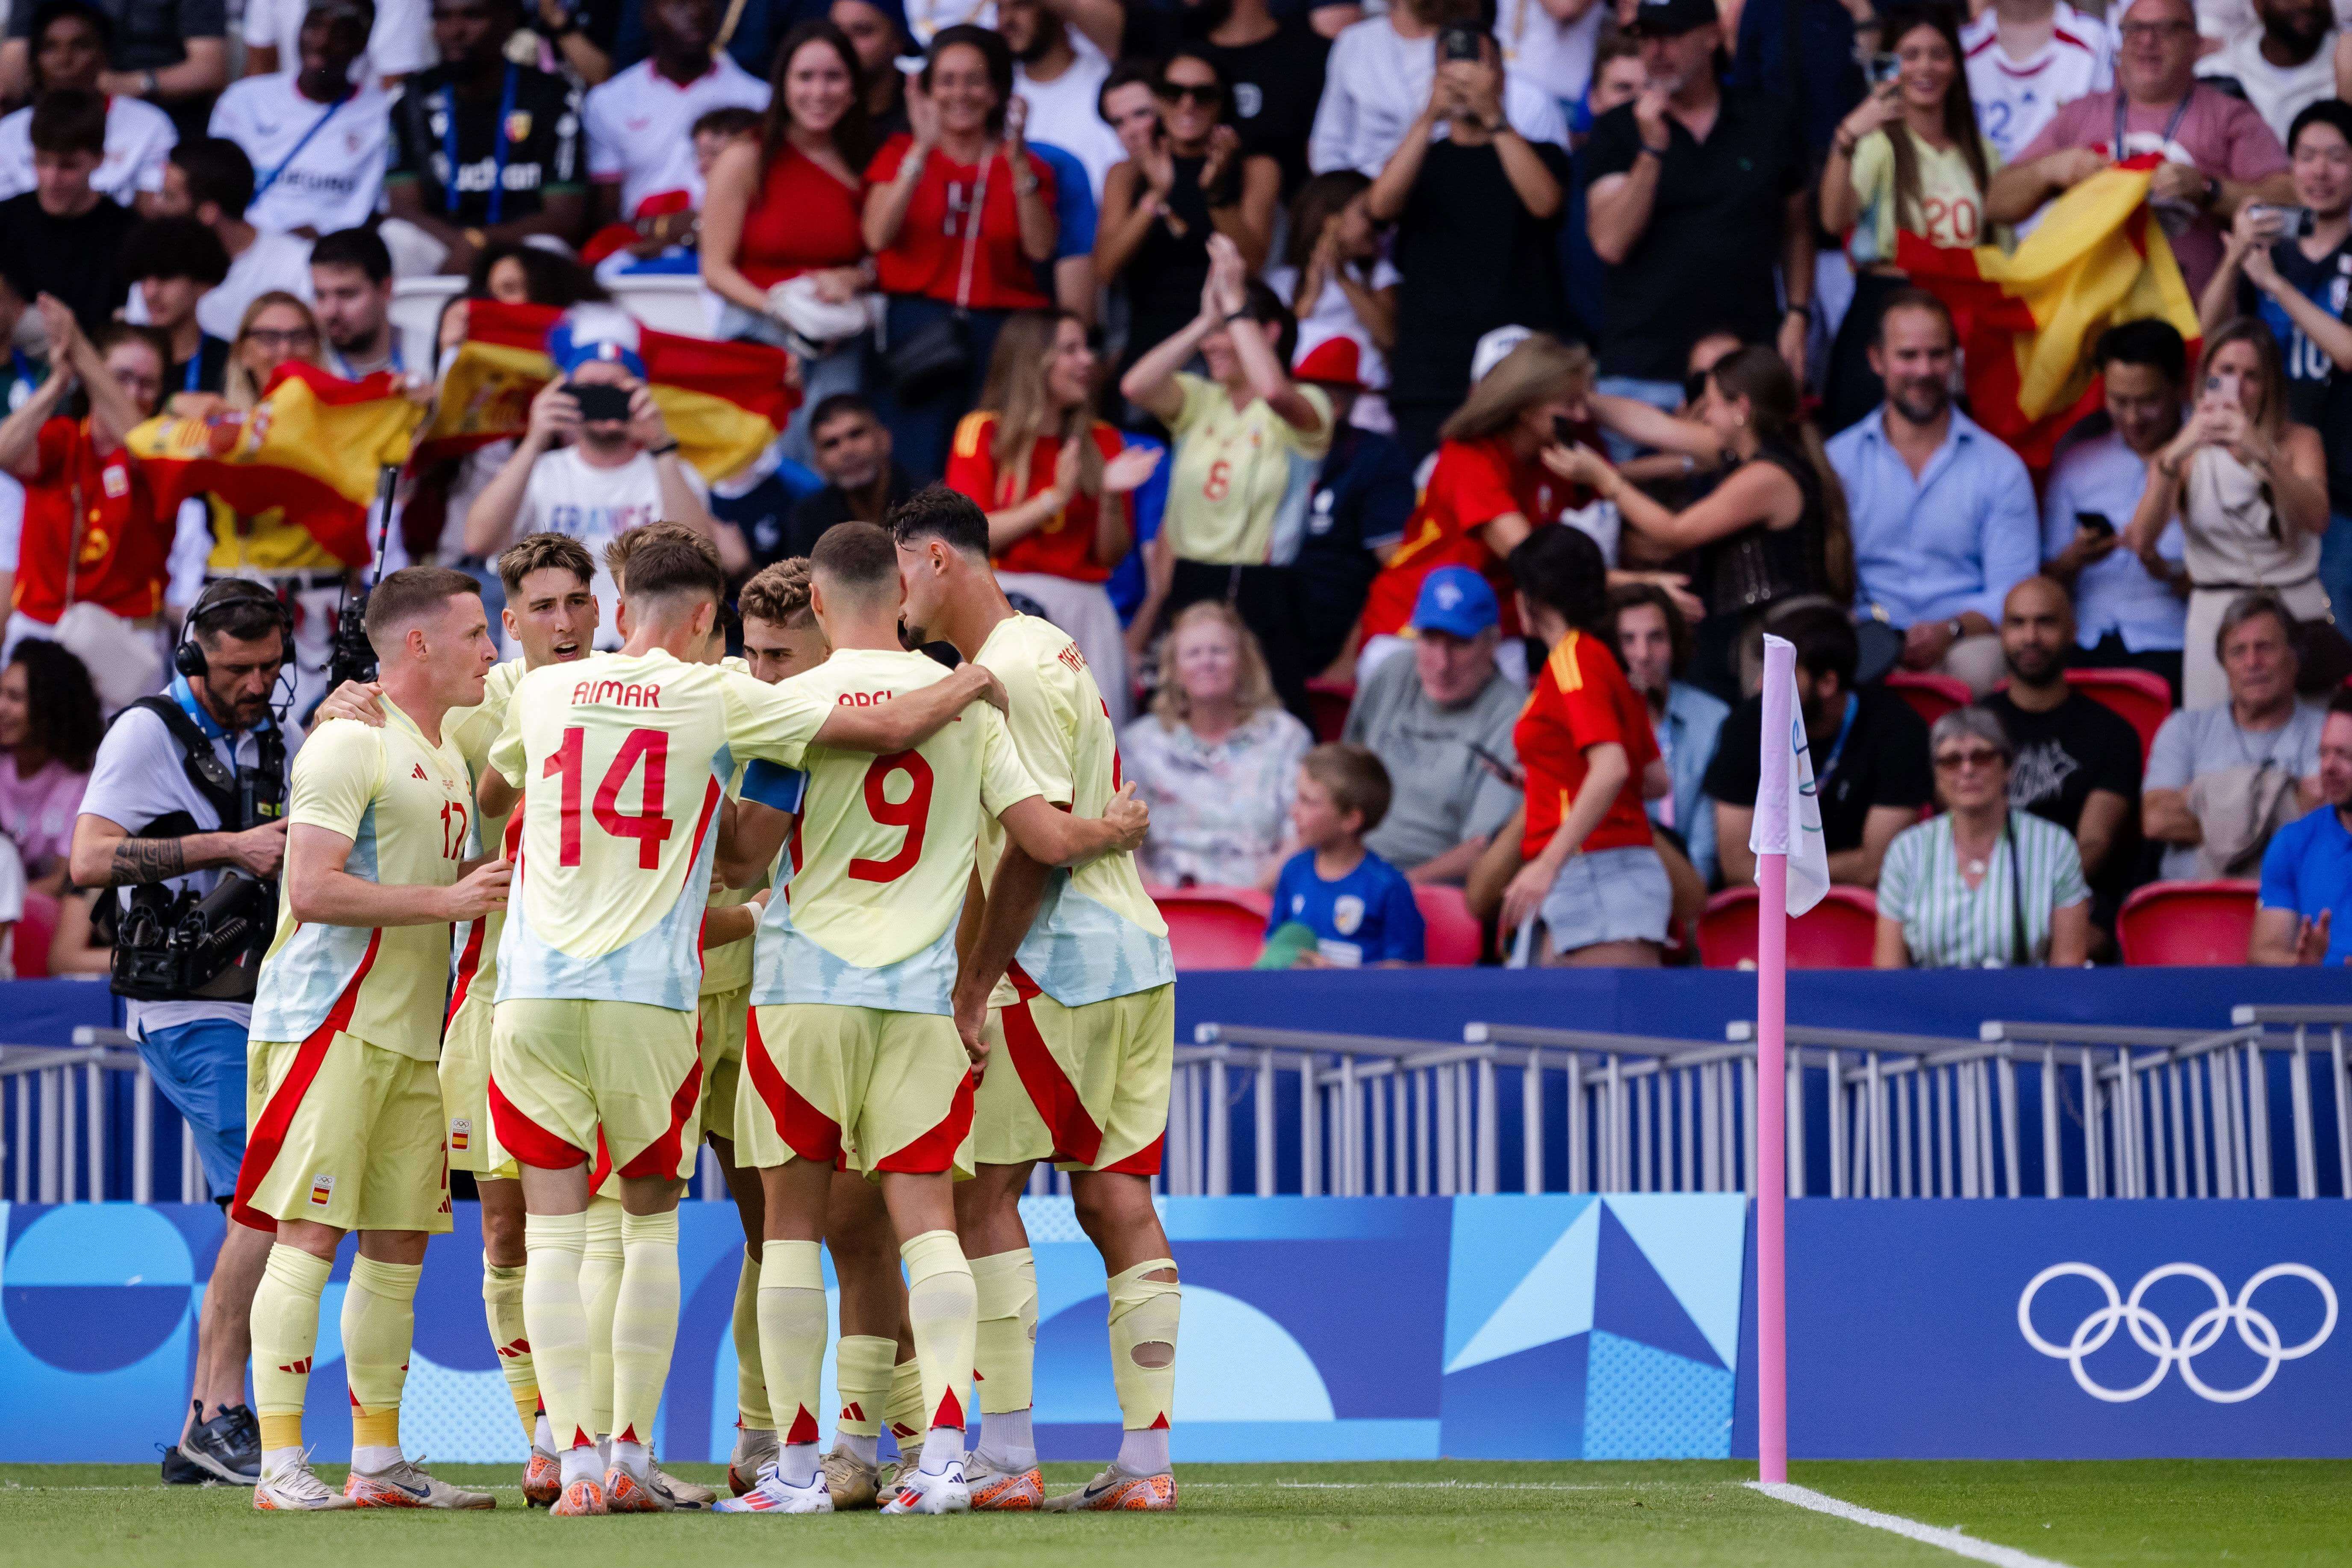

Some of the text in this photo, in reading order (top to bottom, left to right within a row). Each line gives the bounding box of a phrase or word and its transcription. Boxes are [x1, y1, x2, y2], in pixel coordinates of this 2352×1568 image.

[1924, 196, 1977, 241] 20
[572, 680, 660, 708] AIMAR
[543, 727, 673, 870] 14
[848, 748, 934, 883] 9
[441, 800, 467, 860] 17
